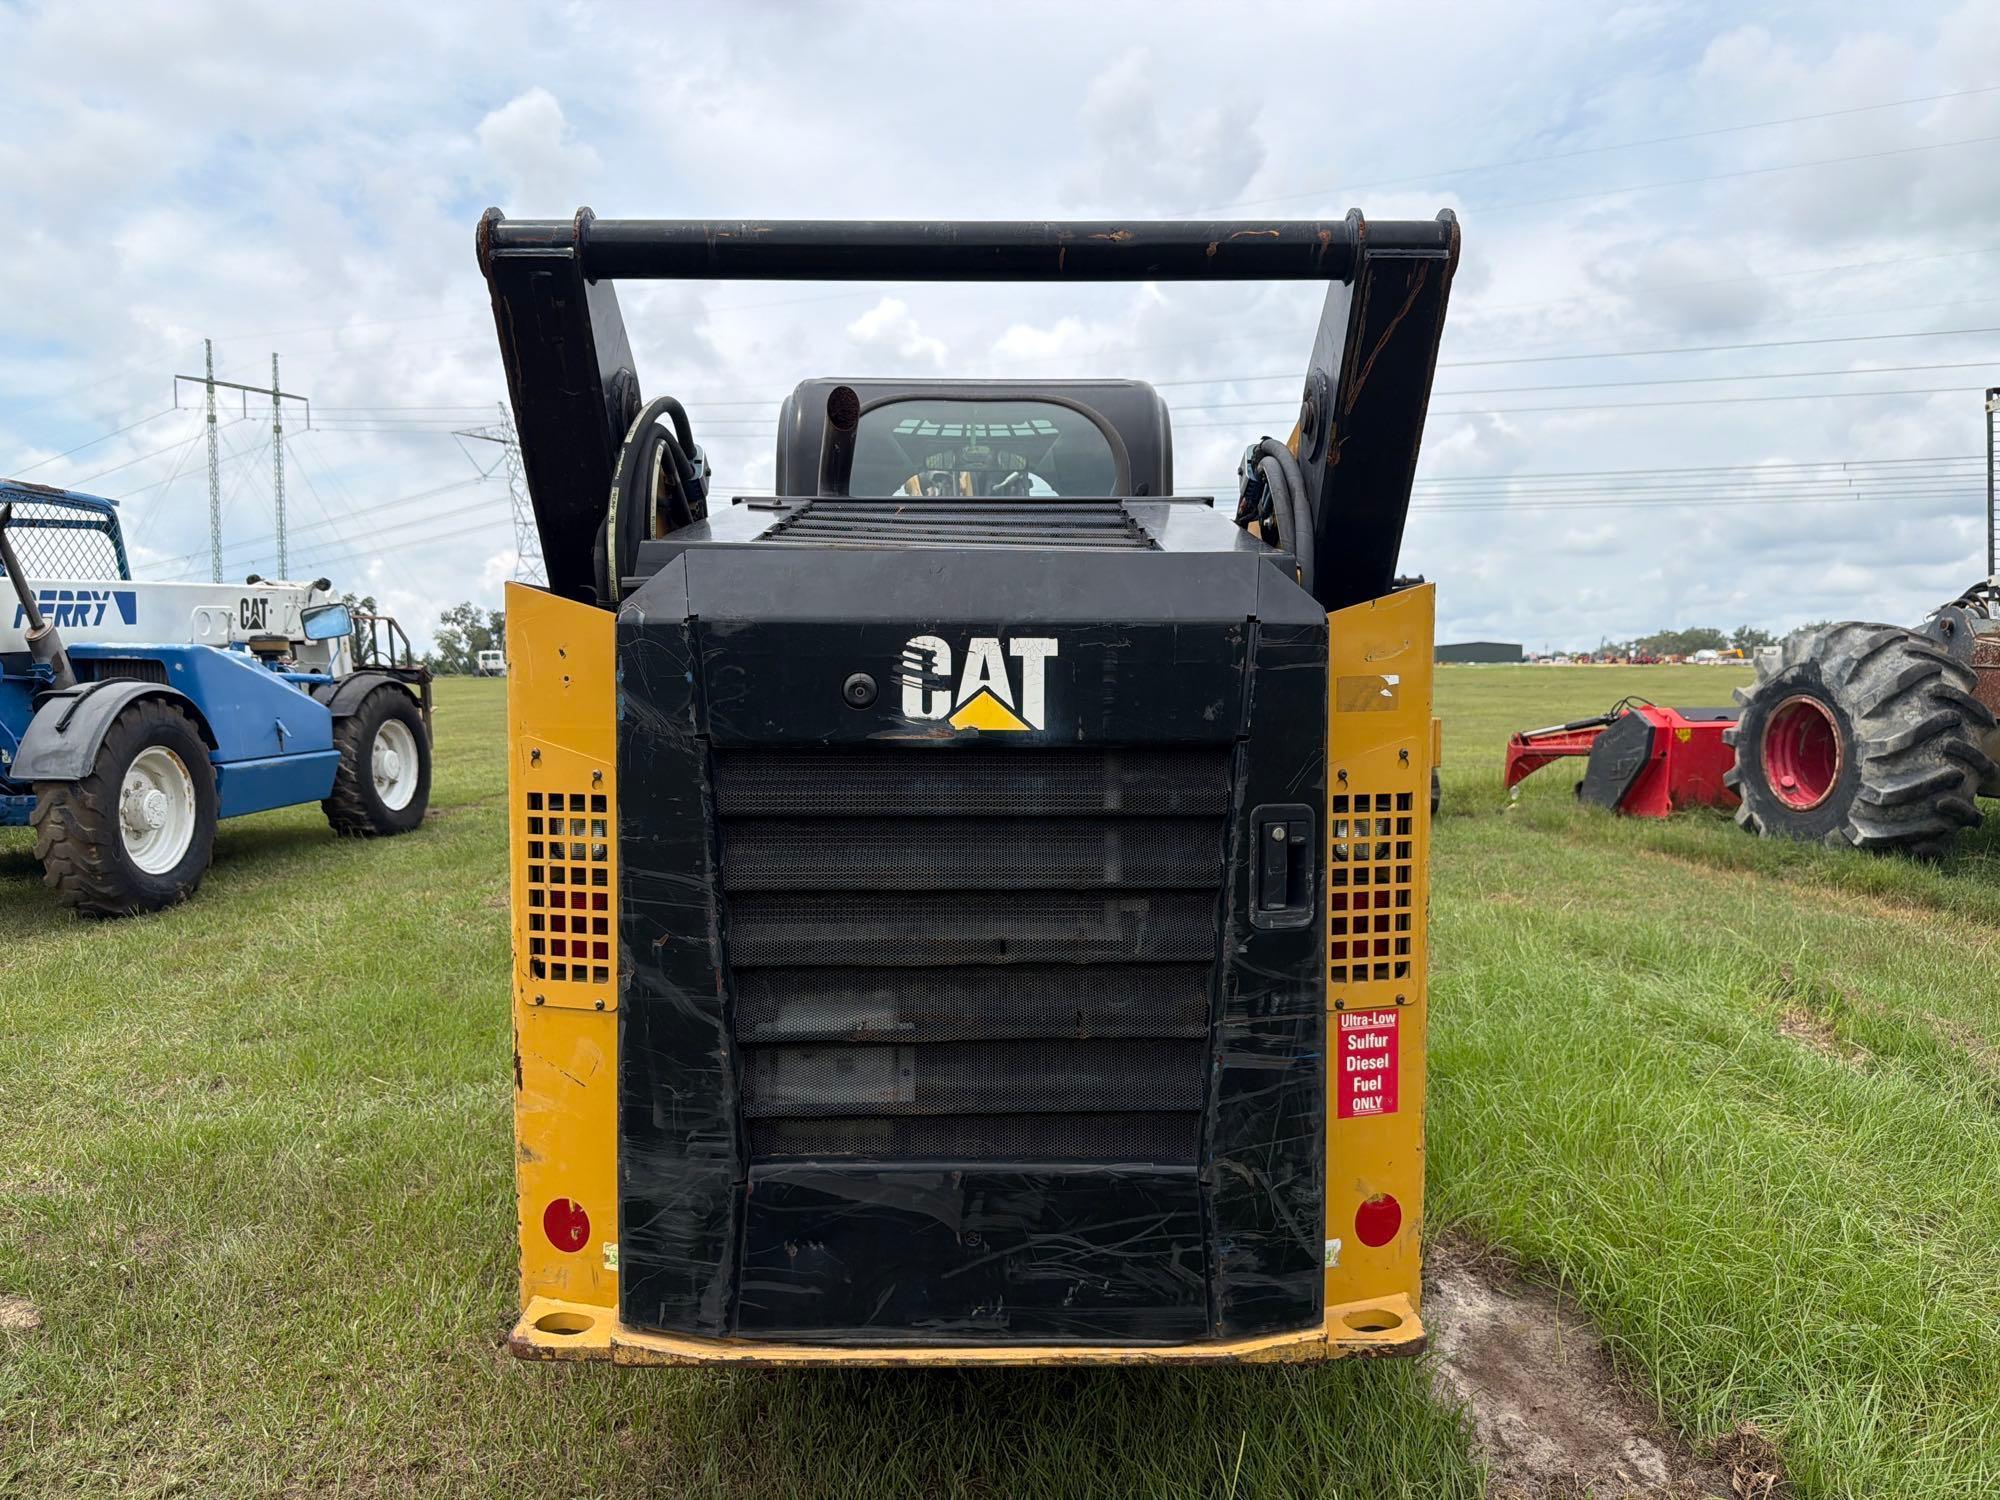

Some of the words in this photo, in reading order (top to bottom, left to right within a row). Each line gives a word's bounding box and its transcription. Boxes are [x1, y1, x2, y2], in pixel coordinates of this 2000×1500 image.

[240, 598, 268, 630] CAT
[901, 635, 1059, 731] CAT
[1341, 1012, 1396, 1028] Ultra-Low
[1347, 1033, 1388, 1050] Sulfur
[1346, 1053, 1389, 1072] Diesel
[1352, 1075, 1382, 1092] Fuel
[1352, 1096, 1383, 1110] ONLY
